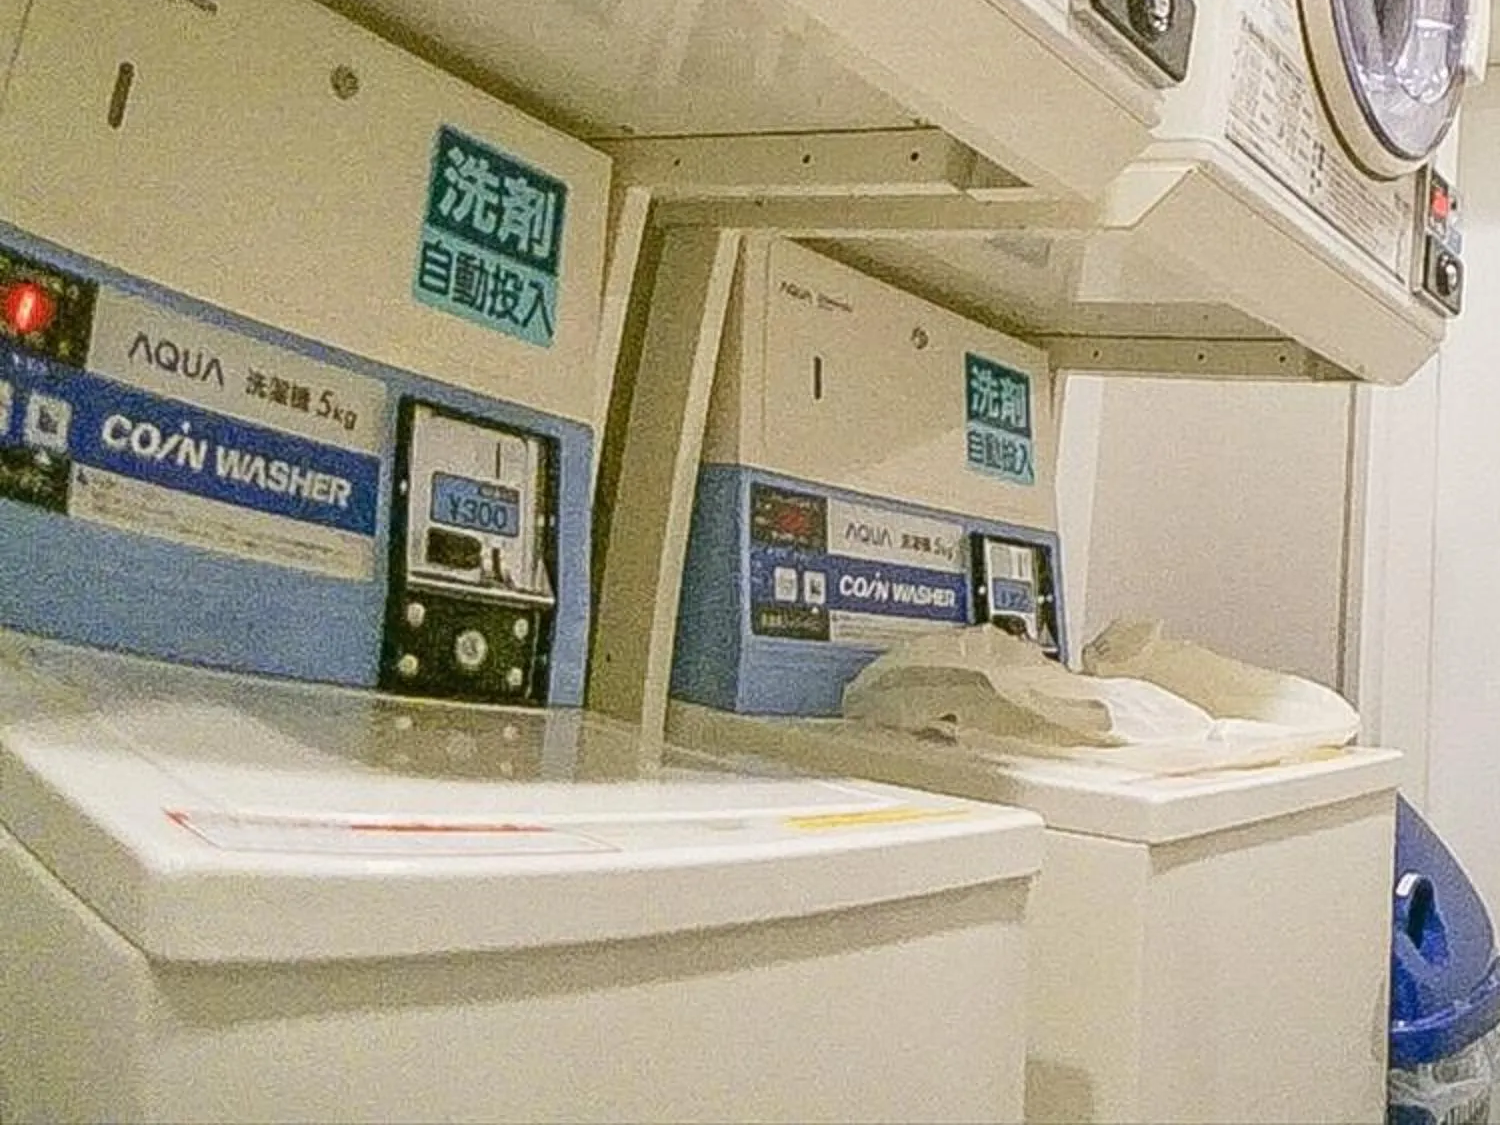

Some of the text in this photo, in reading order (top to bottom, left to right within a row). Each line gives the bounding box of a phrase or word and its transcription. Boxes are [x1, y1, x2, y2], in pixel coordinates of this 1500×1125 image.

[436, 145, 557, 257] 洗剤
[416, 239, 555, 339] 自動投入
[128, 330, 226, 387] AQUA
[315, 389, 359, 432] 5kg
[970, 365, 1029, 430] 洗剤
[214, 443, 353, 510] WASHER
[845, 521, 893, 549] AQUA
[891, 583, 957, 608] WASHER
